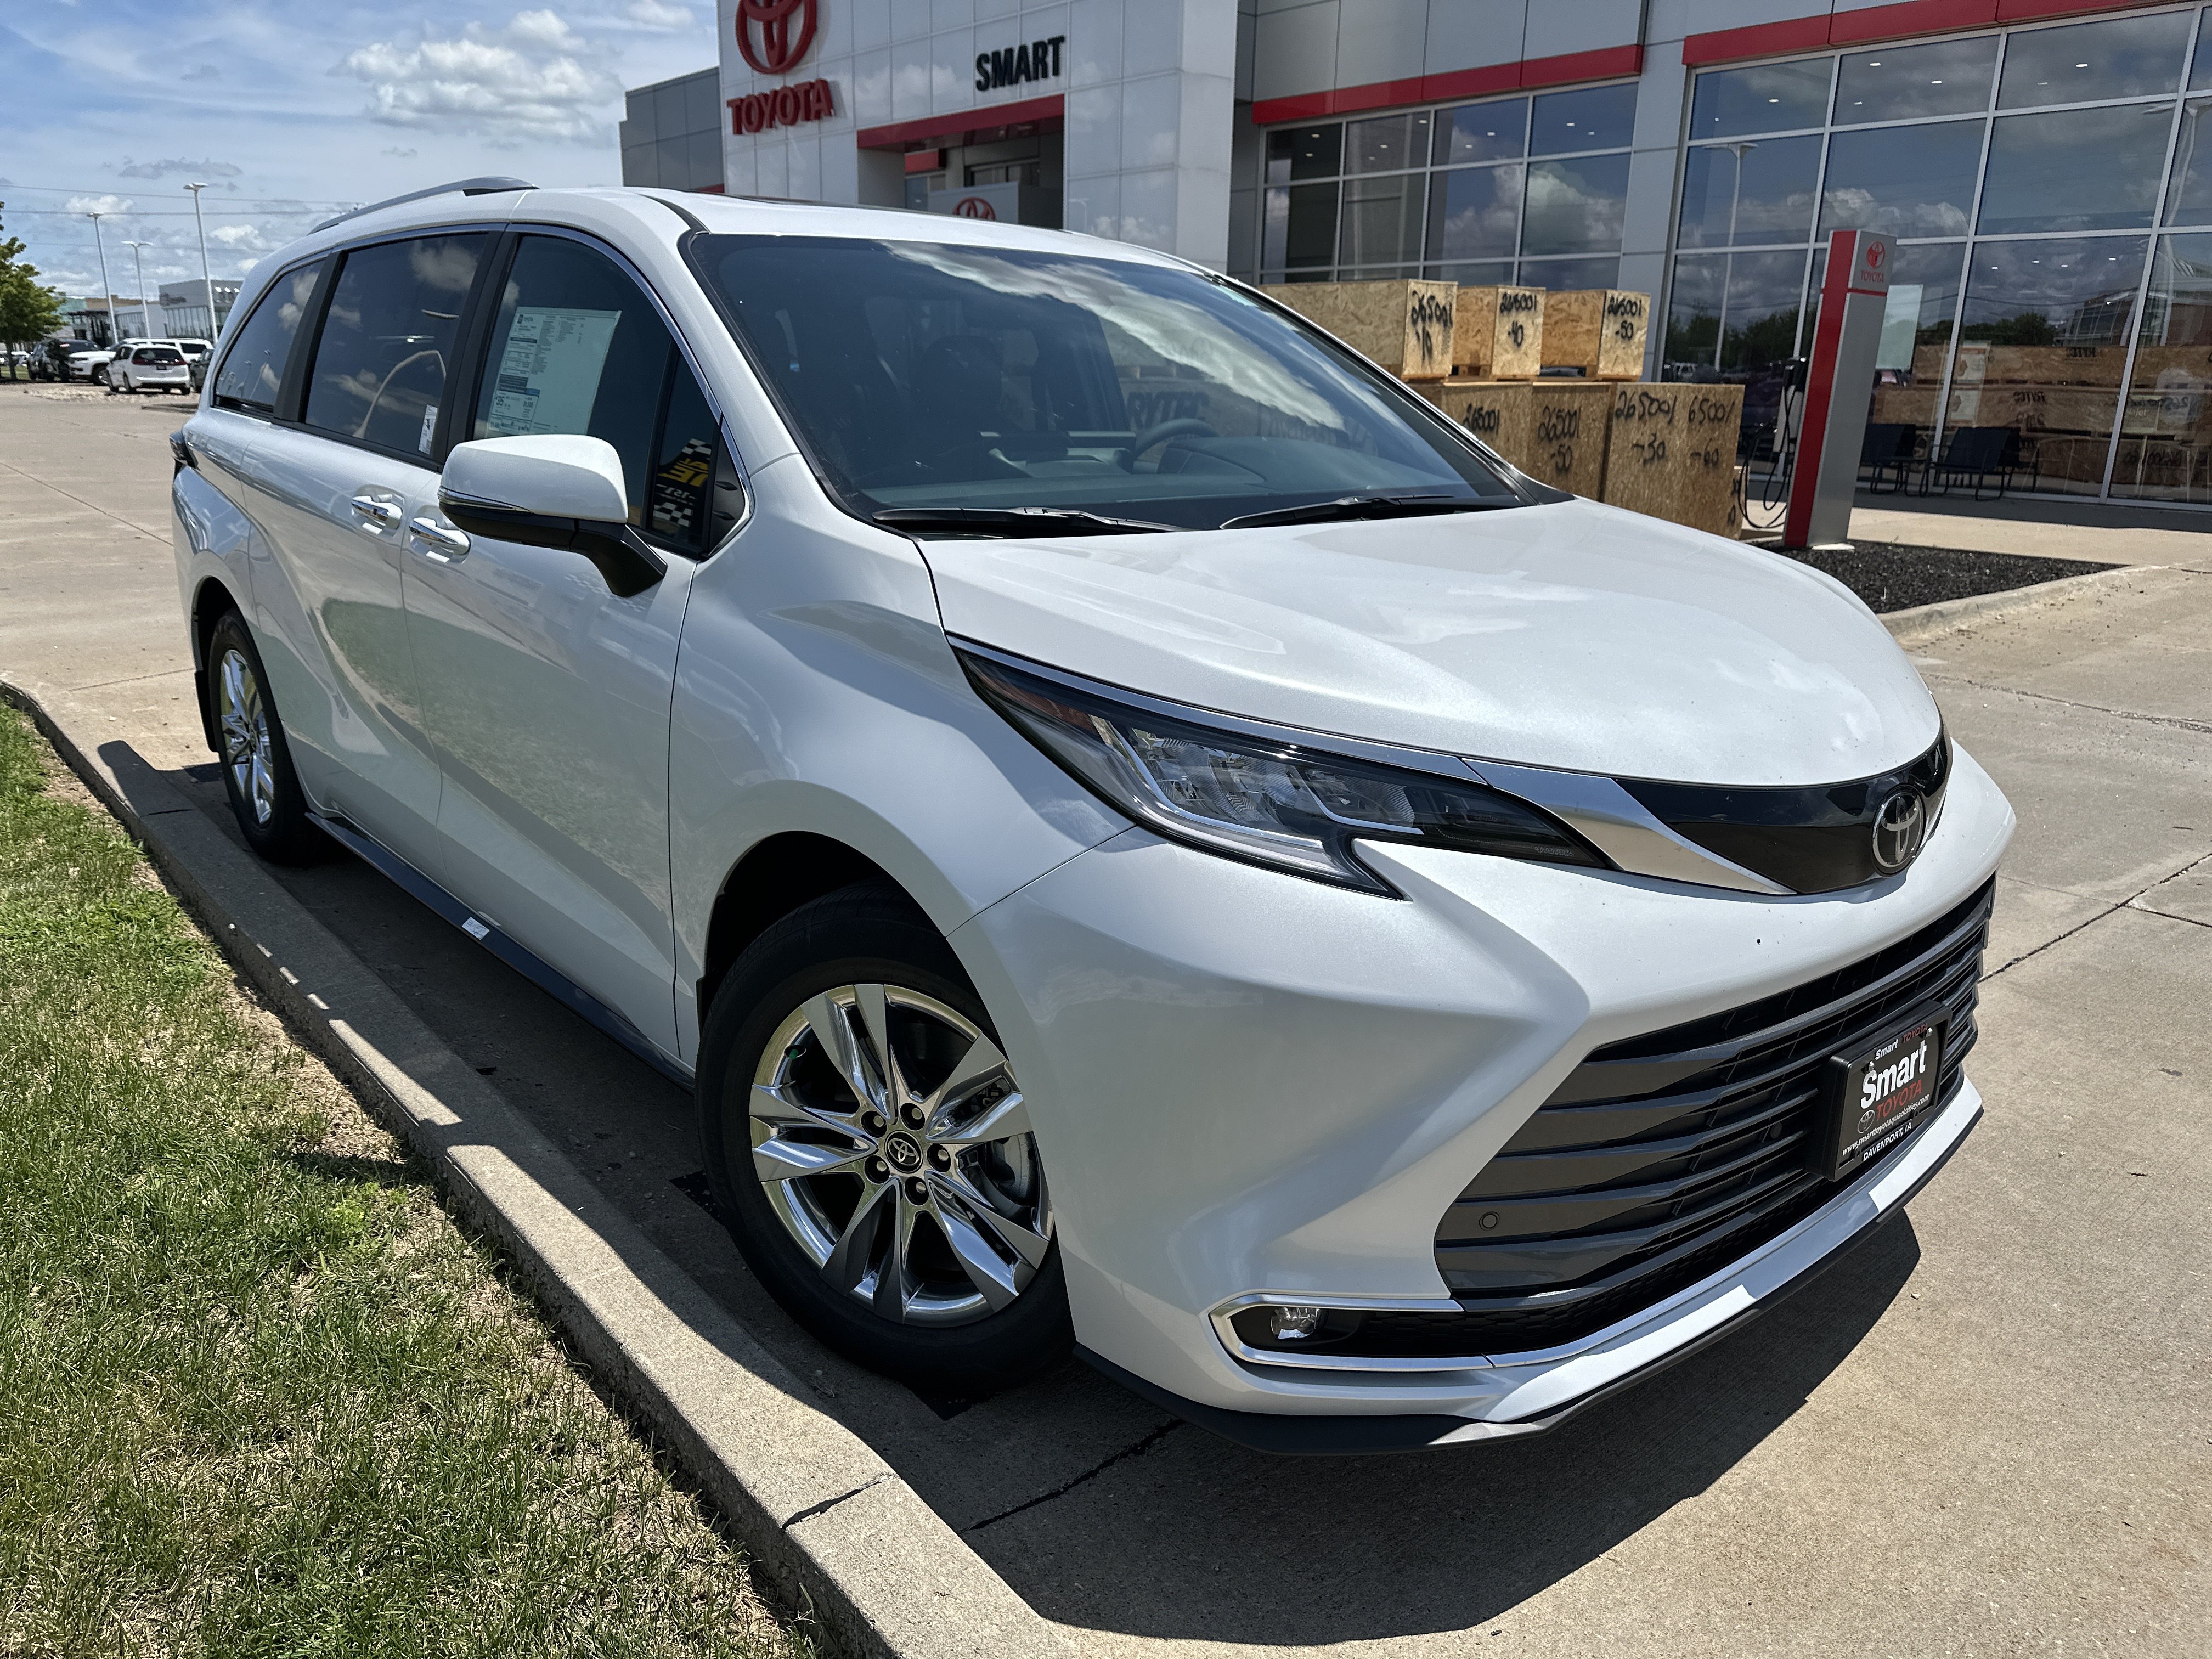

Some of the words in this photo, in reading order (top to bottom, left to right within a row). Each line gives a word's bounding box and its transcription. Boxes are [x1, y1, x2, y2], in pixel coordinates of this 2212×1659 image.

[975, 35, 1065, 92] SMART
[727, 78, 834, 135] TOYOTA
[1860, 269, 1884, 283] TOYOTA
[1875, 1039, 1899, 1060] Smart
[1902, 1023, 1928, 1044] TOYOTA
[1860, 1040, 1927, 1109] Smart
[1842, 1093, 1929, 1156] www.smarttoyotaquadcities.com
[1875, 1079, 1923, 1122] TOYOTA
[1863, 1127, 1904, 1161] DAVENPORT,
[1904, 1122, 1912, 1133] IA
